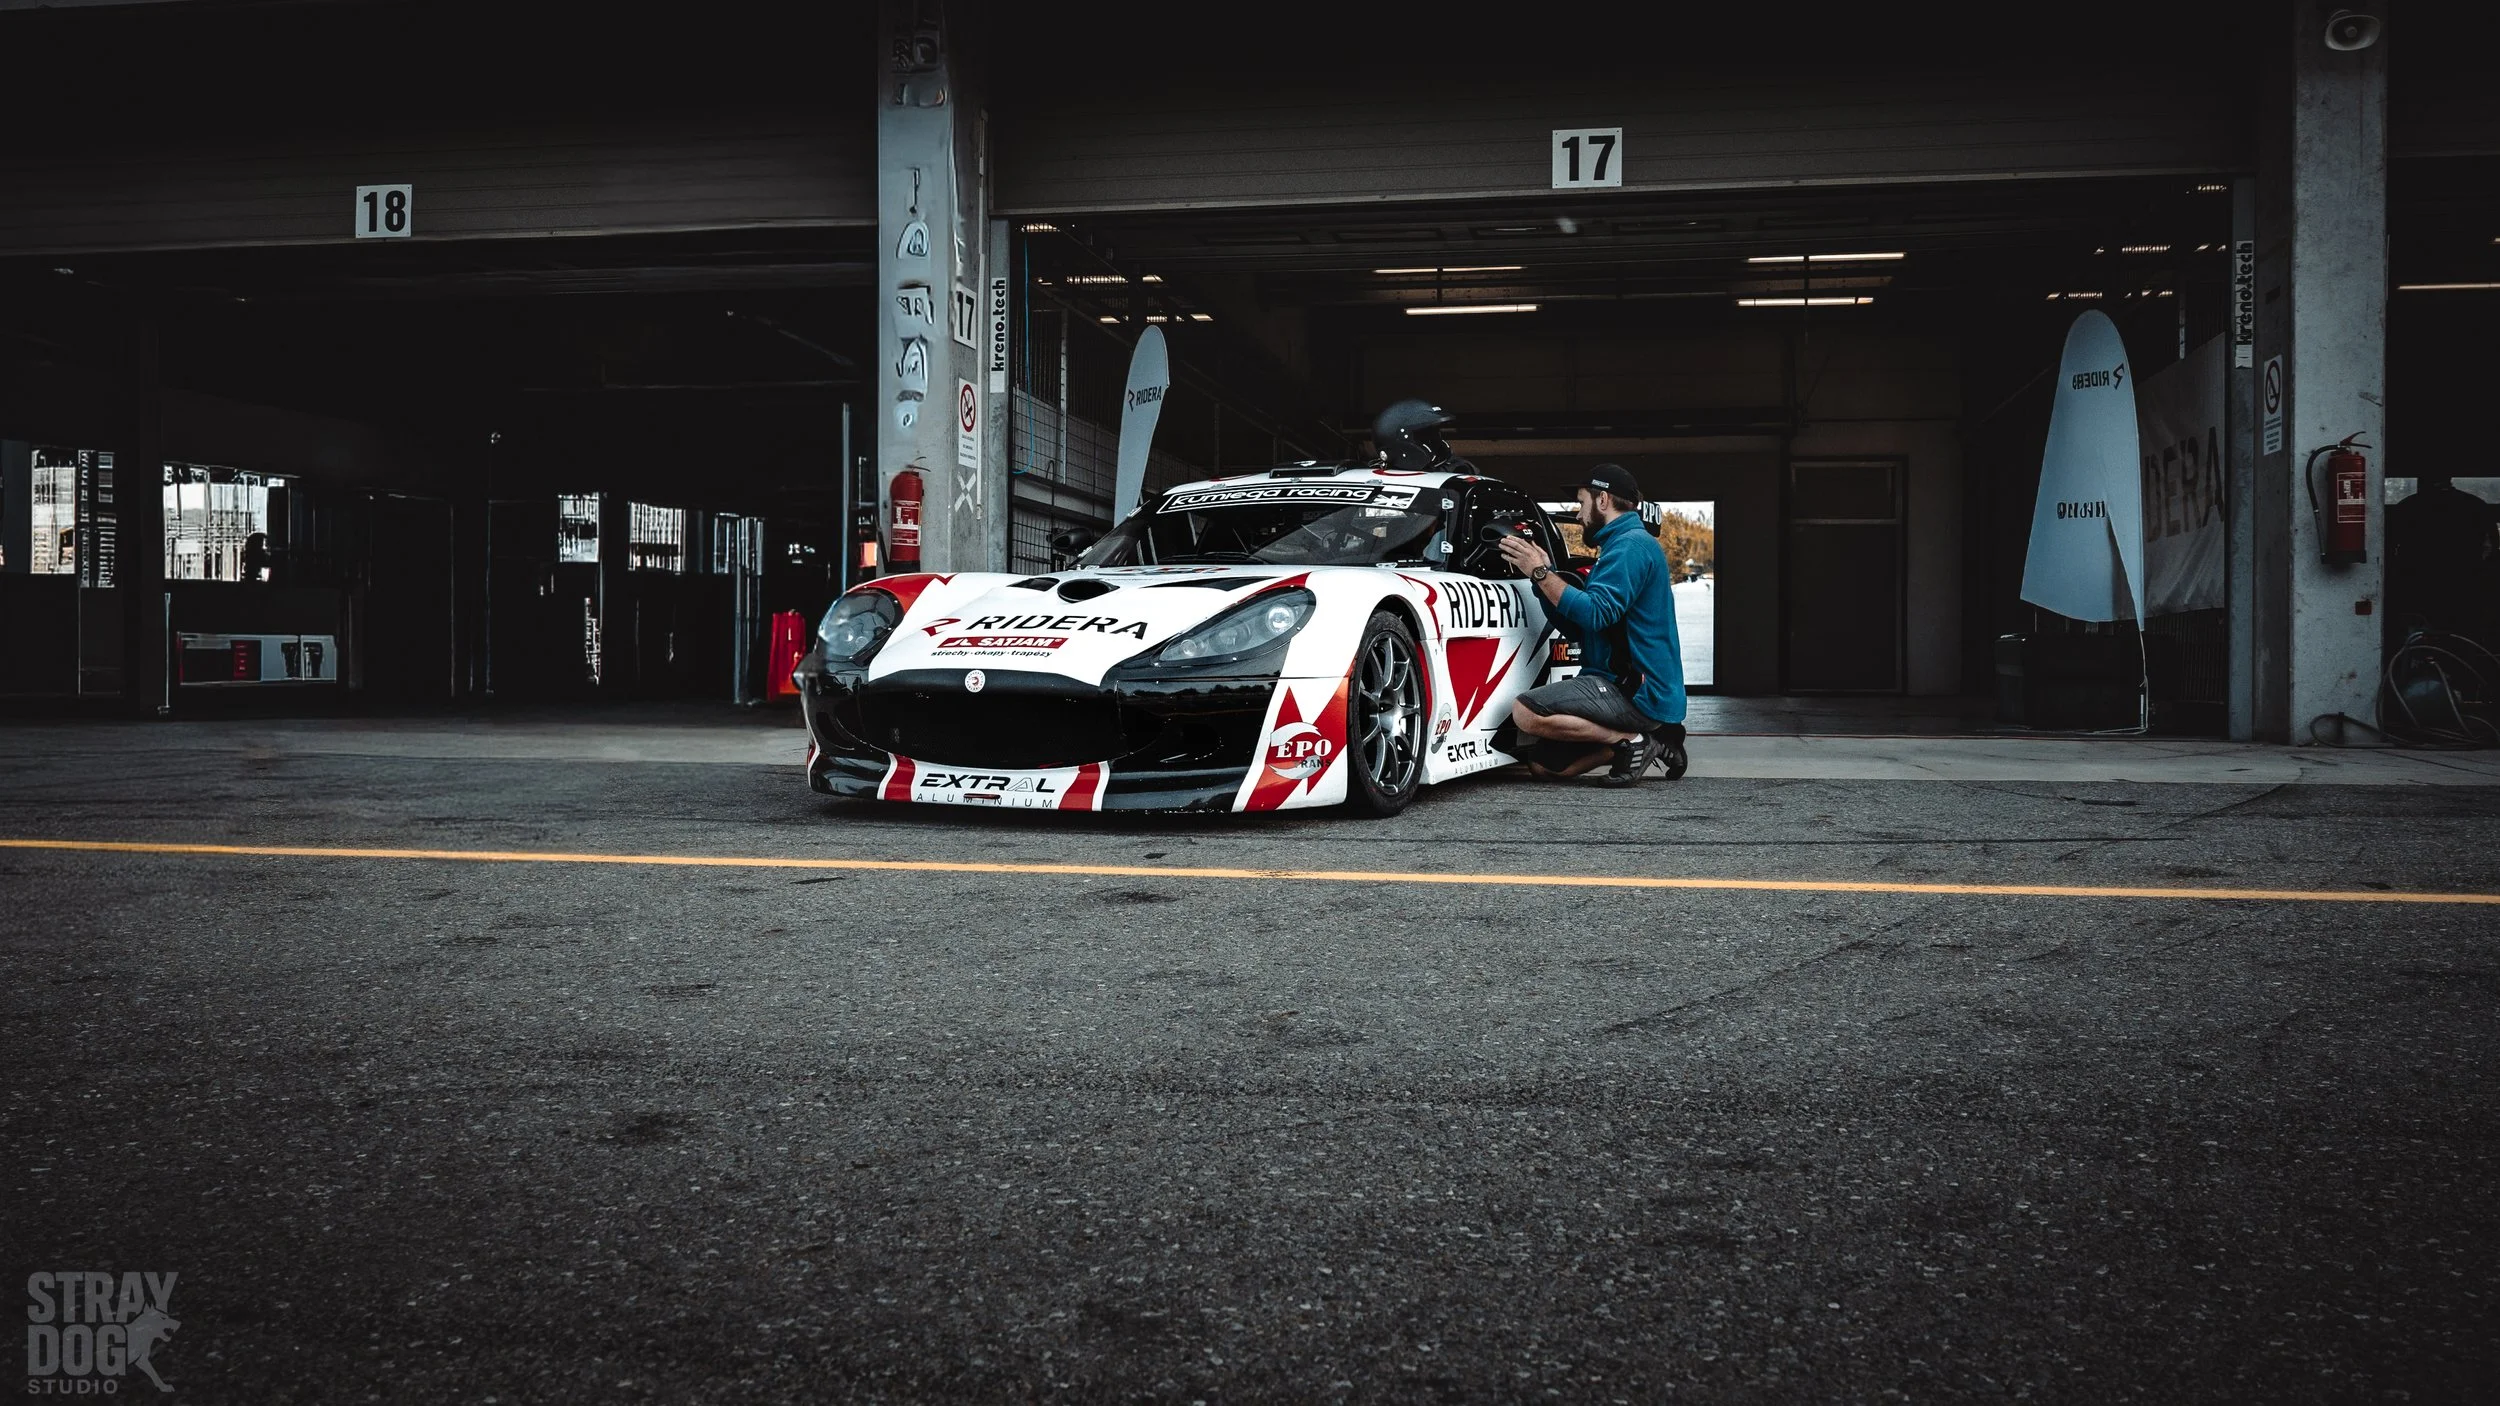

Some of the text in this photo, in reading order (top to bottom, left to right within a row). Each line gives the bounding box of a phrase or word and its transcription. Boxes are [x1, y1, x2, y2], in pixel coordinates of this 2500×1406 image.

[1562, 135, 1615, 181] 17
[364, 190, 406, 232] 18
[2237, 243, 2252, 345] kreno.tech
[956, 291, 974, 340] 17
[992, 280, 1005, 371] kreno.tech
[1136, 386, 1161, 406] RIDERA
[1172, 487, 1371, 505] kumiega racing
[1643, 500, 1661, 525] EPO
[1440, 581, 1528, 628] RIDERA
[965, 615, 1148, 640] RIDERA
[1276, 739, 1332, 758] EPO
[920, 773, 1056, 794] EXTRAL
